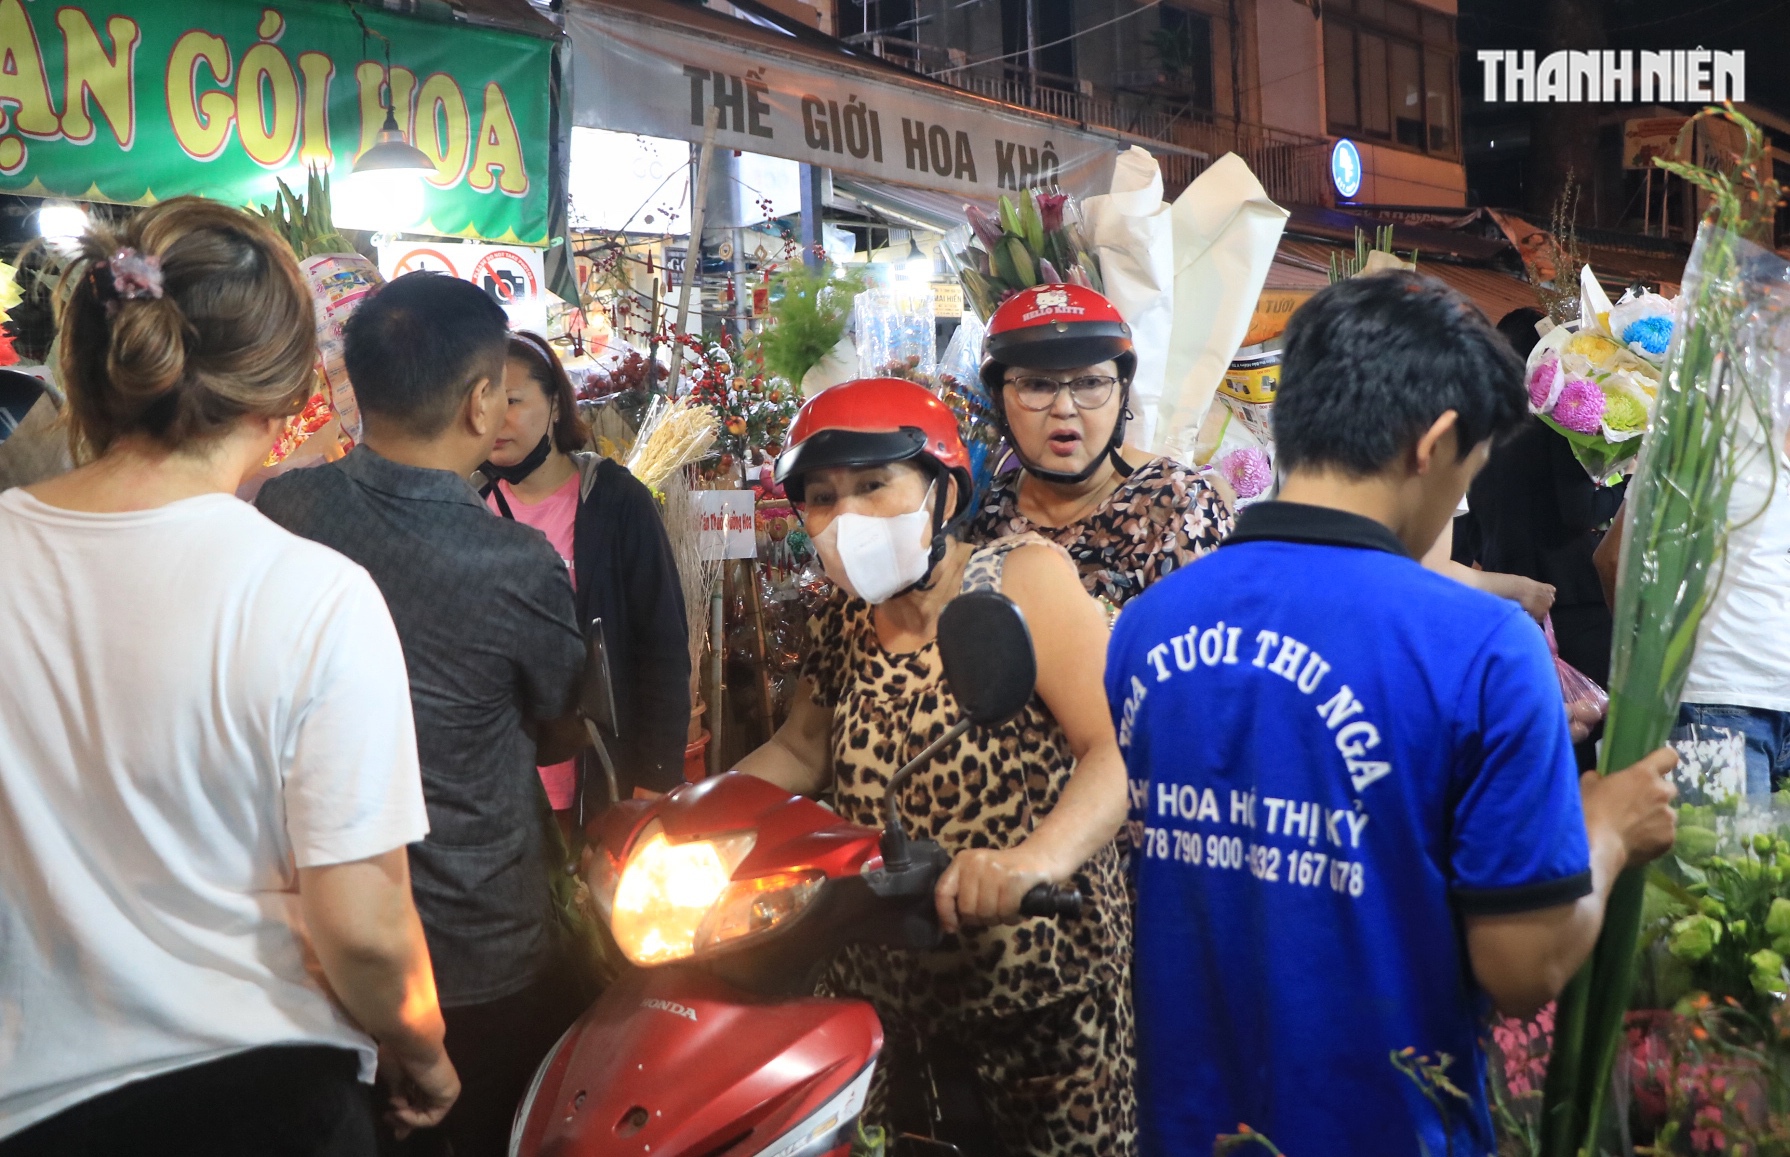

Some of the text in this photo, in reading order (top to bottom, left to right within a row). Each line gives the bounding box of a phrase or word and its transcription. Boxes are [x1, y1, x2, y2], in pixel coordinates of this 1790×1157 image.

[165, 8, 335, 170] GÓI
[353, 60, 531, 198] HOA
[682, 63, 1060, 192] THẾ GIỚI HOA KHÔ
[486, 254, 495, 262] DO
[505, 252, 519, 262] TAKE
[518, 259, 534, 280] PHOTOS
[1022, 306, 1086, 322] HELLO KITTY
[1147, 620, 1243, 683] TƯƠI
[1251, 629, 1332, 695] THU
[1315, 684, 1393, 793] NGA
[1157, 782, 1220, 823] HOA
[1263, 797, 1321, 848] THỊ
[1173, 831, 1201, 865] 790
[1287, 849, 1328, 888] 167
